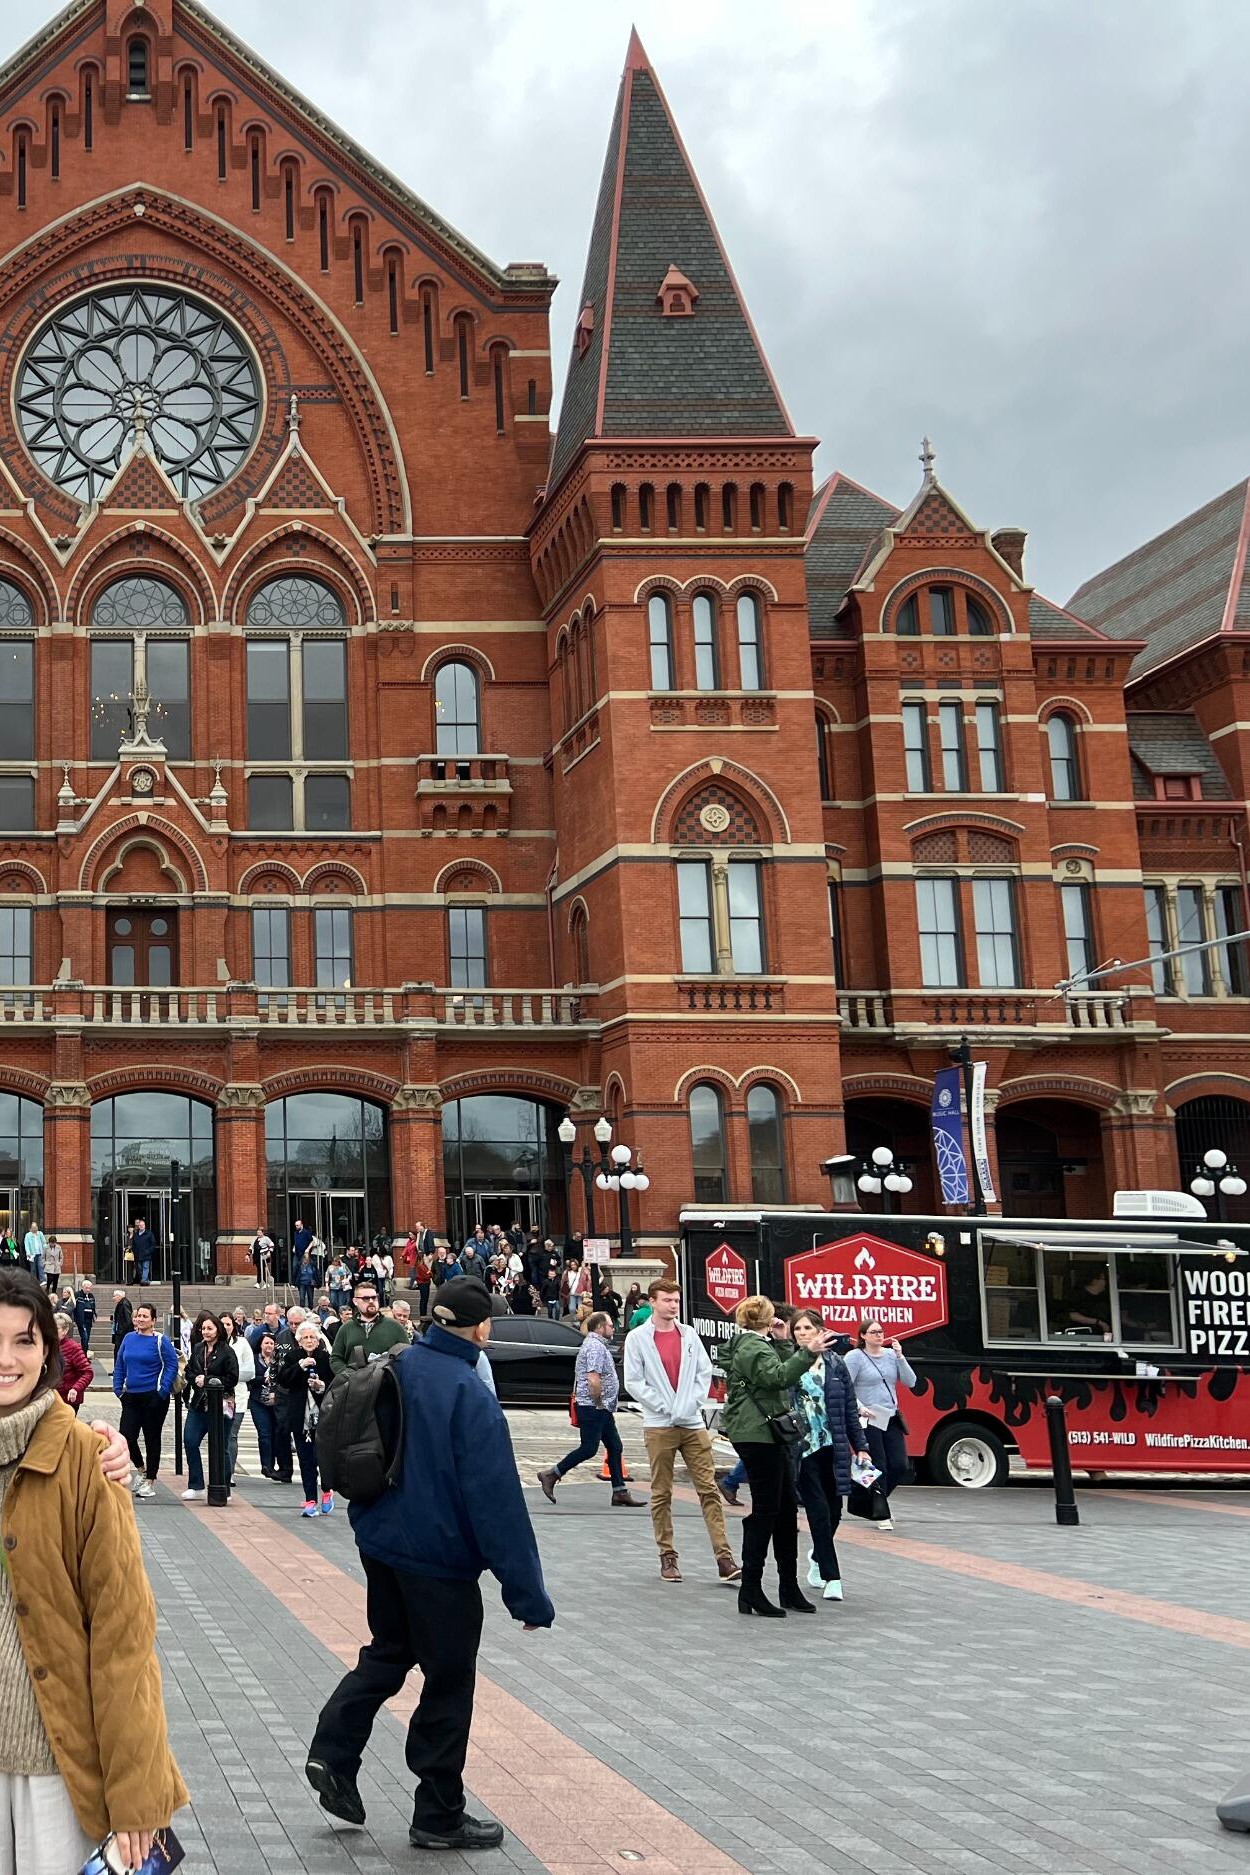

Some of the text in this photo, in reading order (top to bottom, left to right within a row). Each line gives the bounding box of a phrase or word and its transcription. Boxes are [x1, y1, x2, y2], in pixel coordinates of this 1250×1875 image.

[708, 1267, 745, 1286] WILDFIRE
[1184, 1270, 1250, 1297] WOO
[795, 1273, 937, 1302] WILDFIRE
[821, 1305, 913, 1324] PIZZA KITCHEN
[1188, 1300, 1250, 1326] FIRE
[692, 1318, 716, 1338] WOOD
[1068, 1431, 1091, 1445] (513)
[1093, 1432, 1136, 1446] 541-WILD
